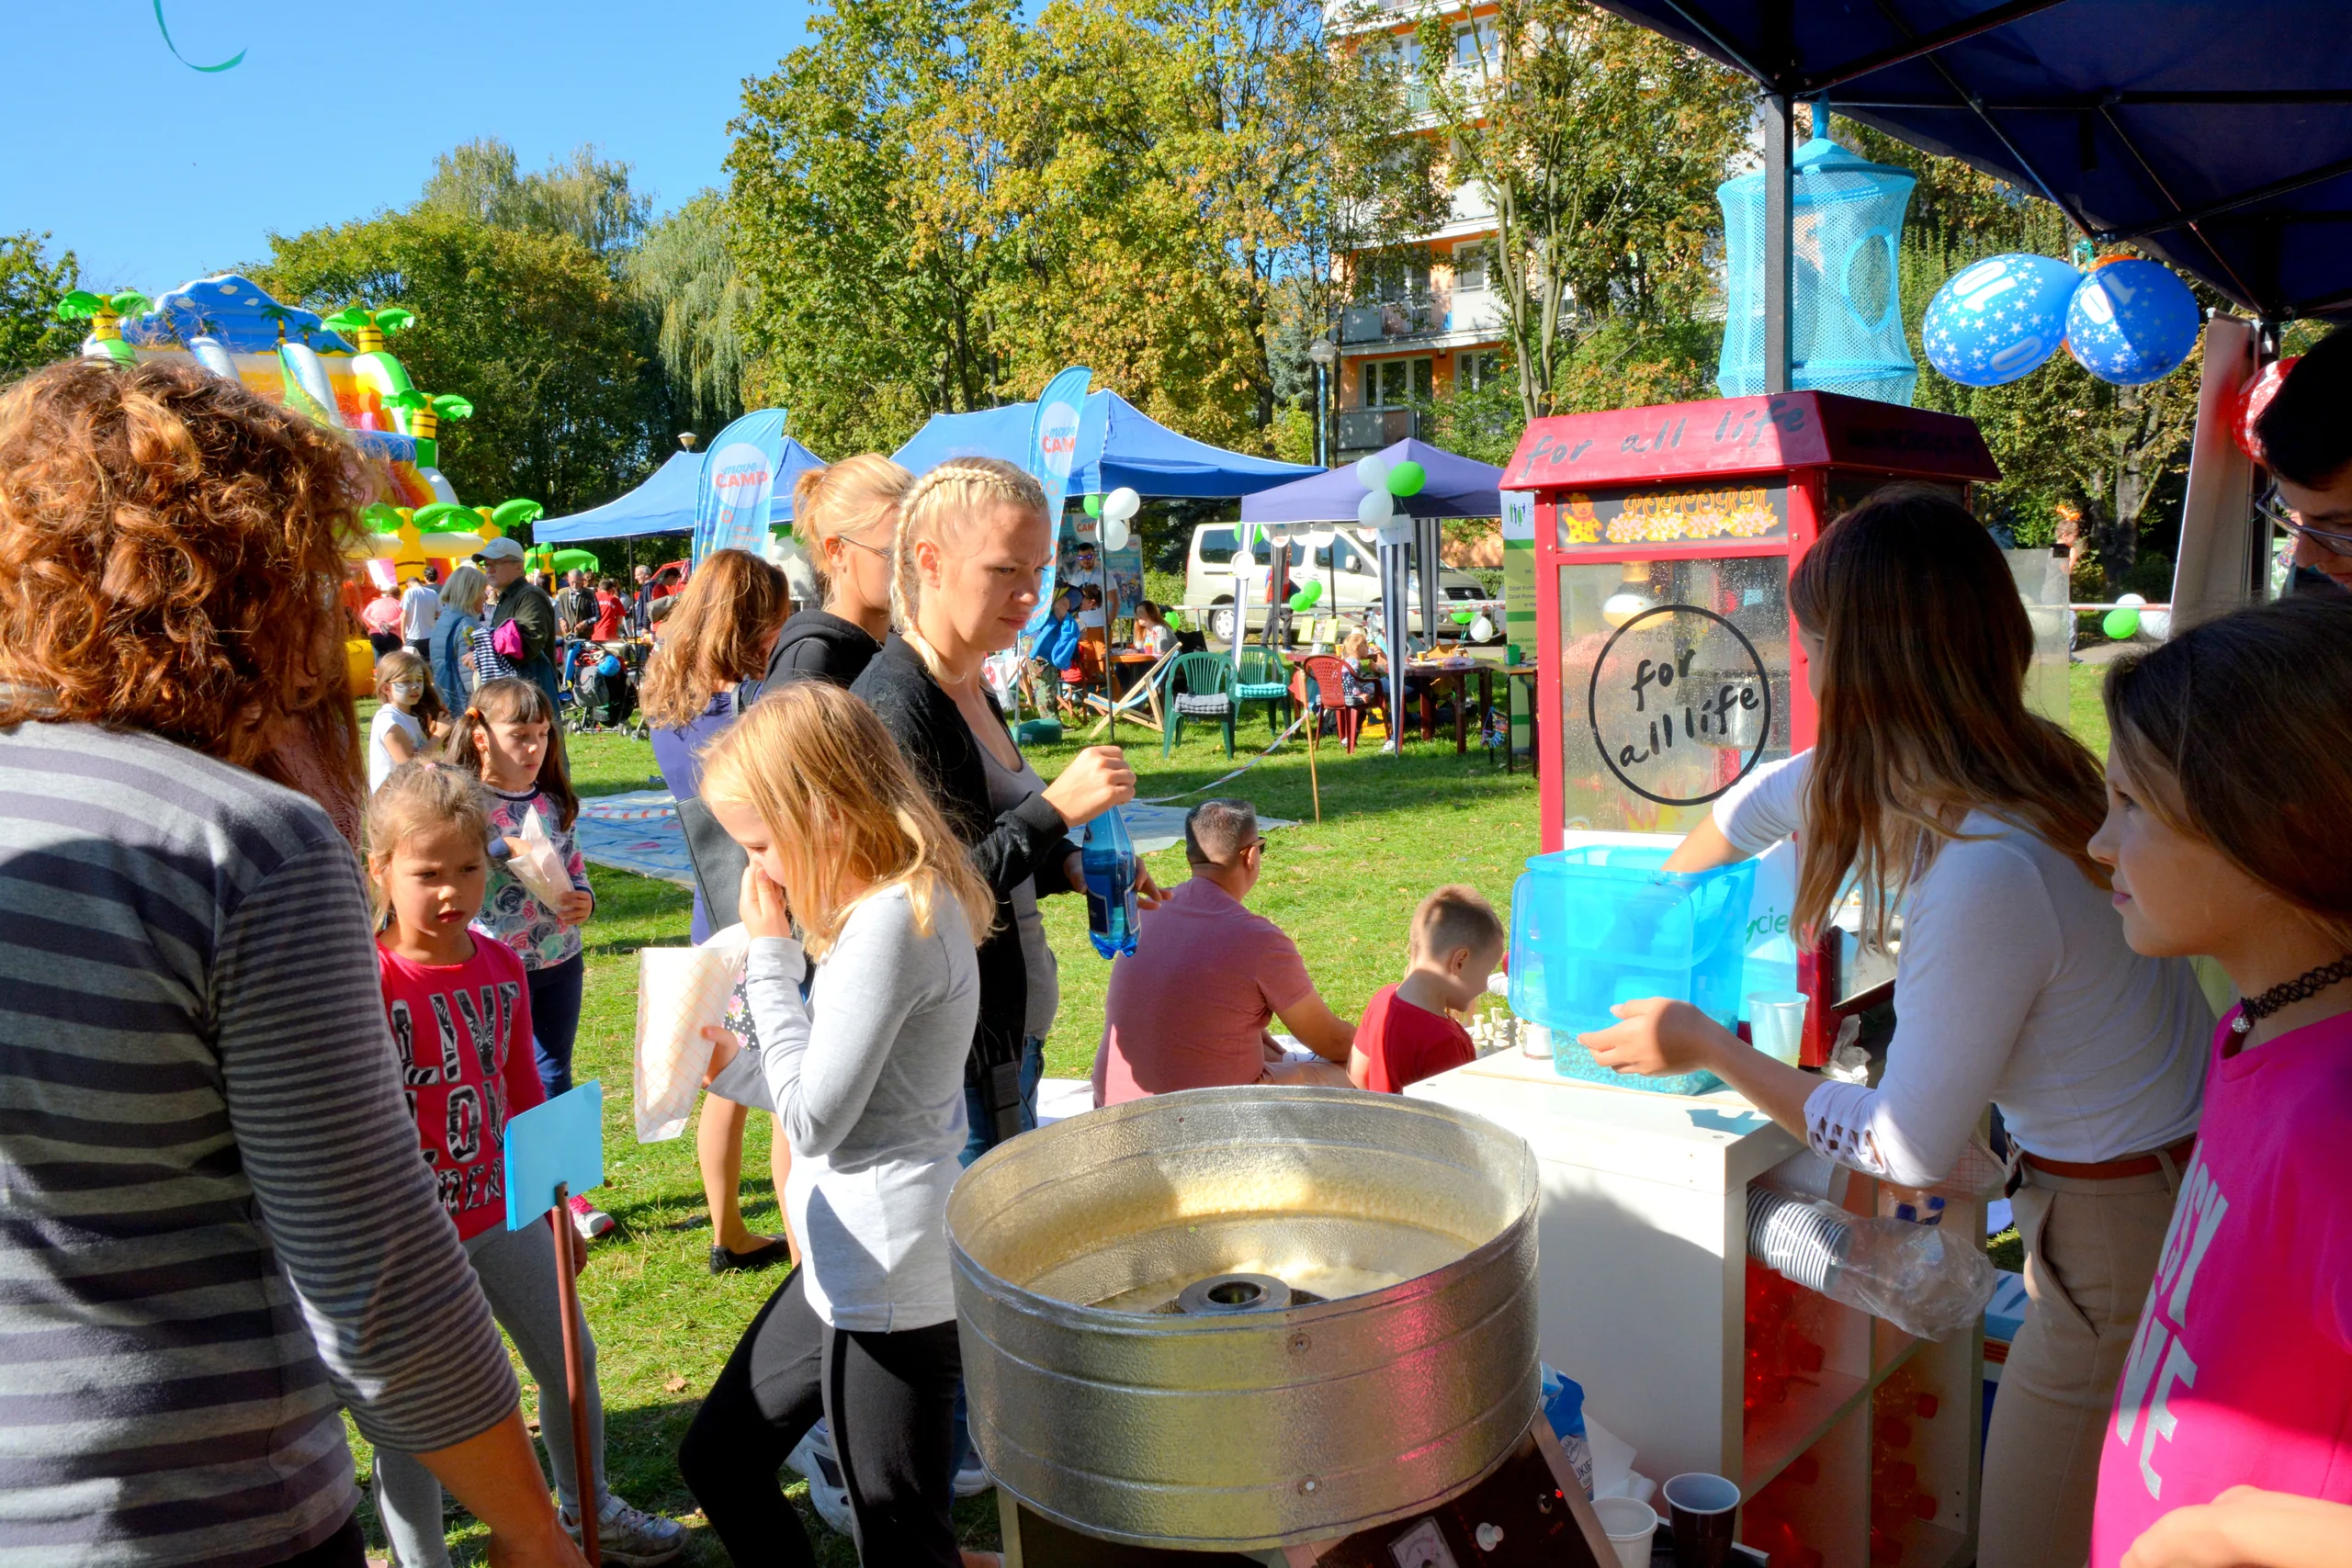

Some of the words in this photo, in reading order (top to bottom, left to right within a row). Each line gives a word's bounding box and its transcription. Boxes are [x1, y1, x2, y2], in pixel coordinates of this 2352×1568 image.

[1042, 435, 1077, 454] CAM
[1521, 434, 1593, 479] for
[1620, 416, 1688, 454] all
[1714, 399, 1805, 449] life
[716, 471, 769, 488] CAMP
[1623, 485, 1774, 518] POPCORN
[1631, 649, 1697, 712] for
[1620, 714, 1673, 768] all
[1685, 684, 1759, 739] life
[404, 1076, 505, 1164] LOV
[438, 1157, 503, 1217] REA
[1576, 1458, 1592, 1480] UKIE
